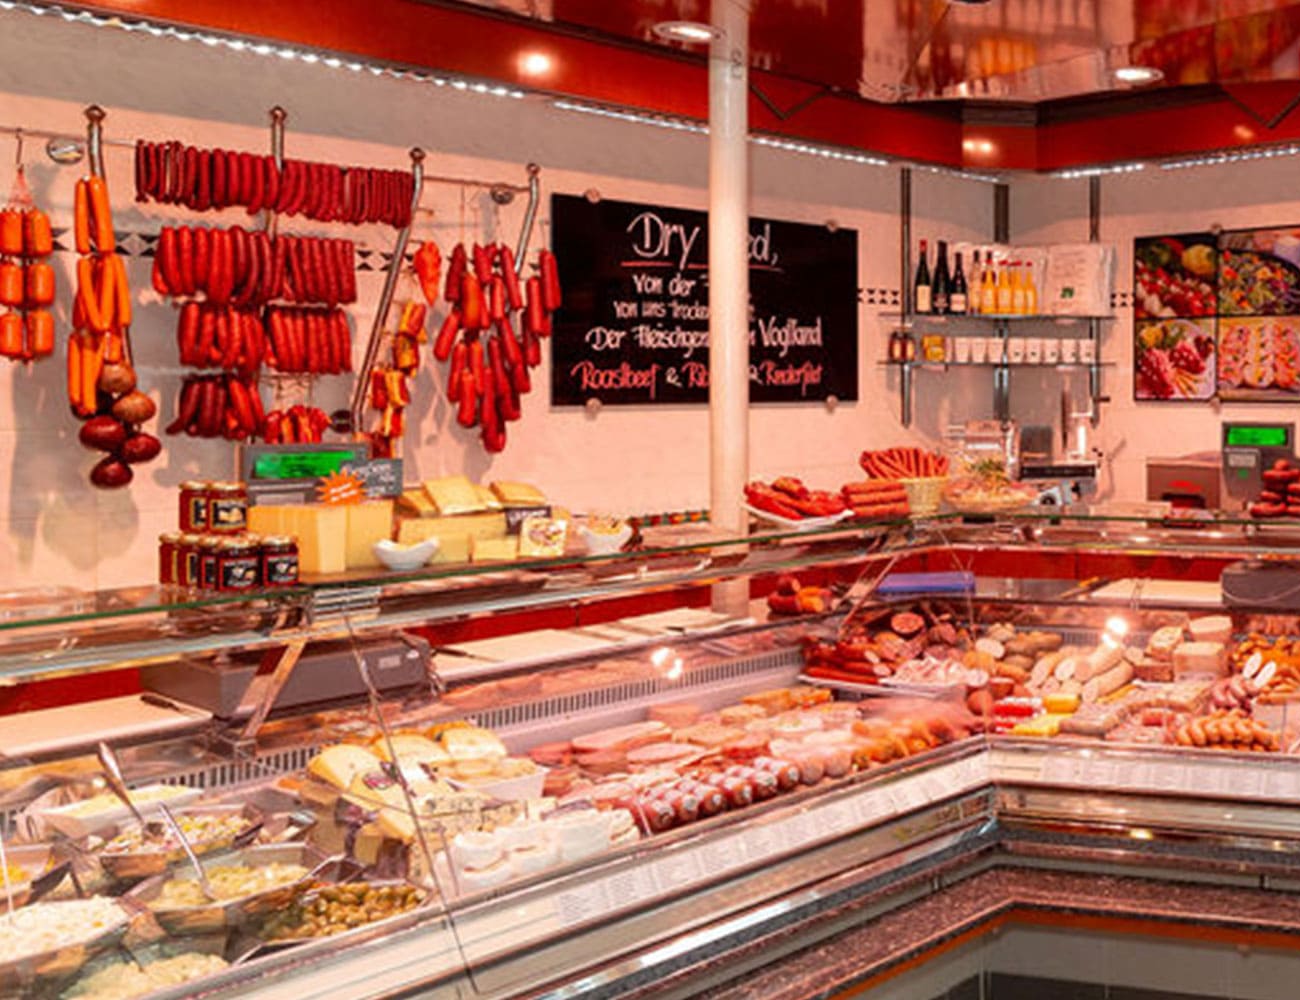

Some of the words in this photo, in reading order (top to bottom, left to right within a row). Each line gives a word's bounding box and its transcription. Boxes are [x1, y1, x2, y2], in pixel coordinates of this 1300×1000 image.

[627, 211, 700, 271] Dry
[633, 273, 662, 295] Von
[668, 273, 697, 297] der
[585, 326, 627, 351] Der
[758, 315, 823, 358] Vogtland
[570, 359, 660, 400] Roastbeef
[665, 366, 684, 388] &
[759, 359, 823, 397] Rinderfilet
